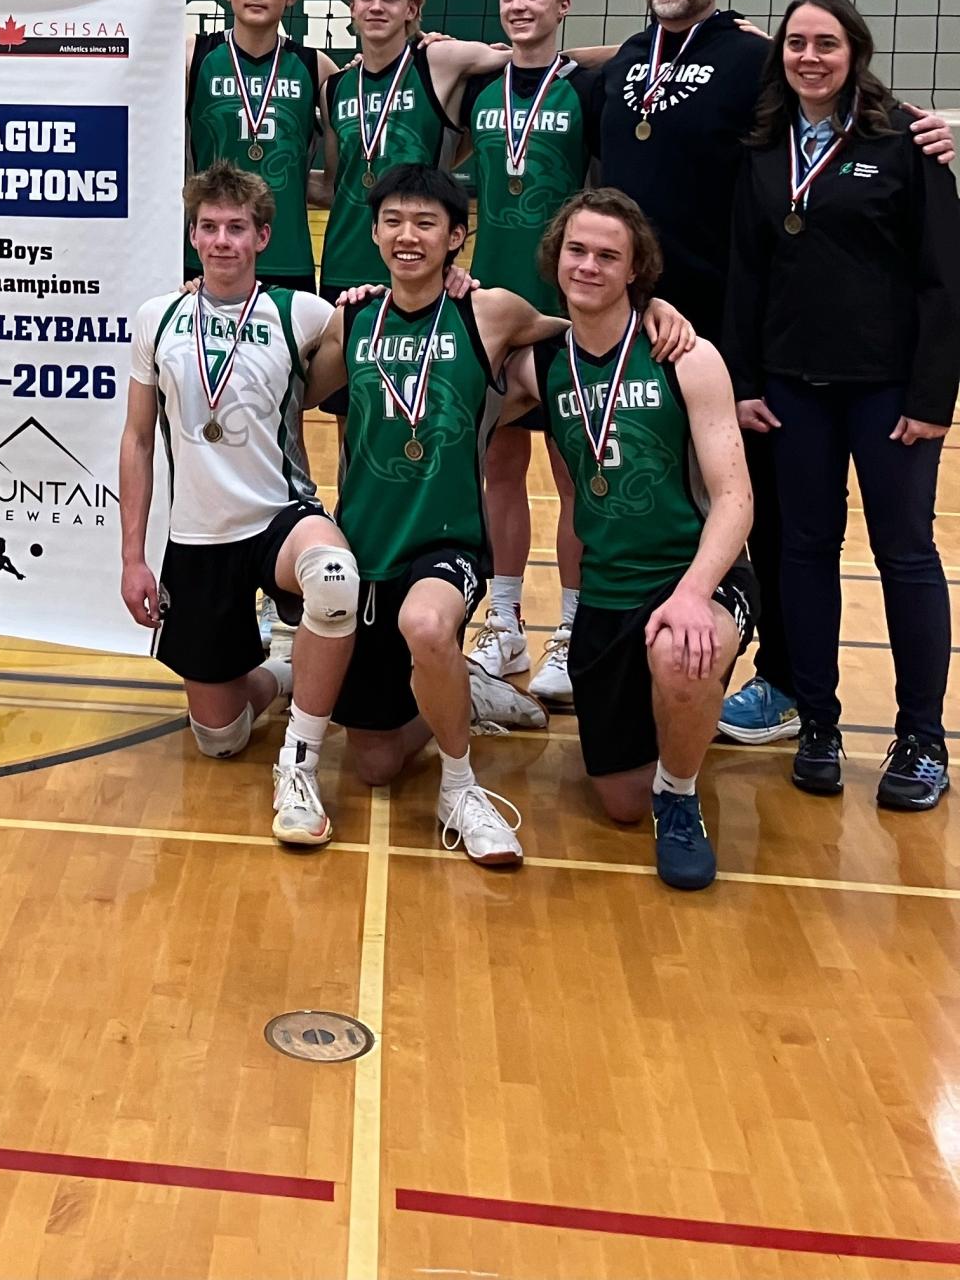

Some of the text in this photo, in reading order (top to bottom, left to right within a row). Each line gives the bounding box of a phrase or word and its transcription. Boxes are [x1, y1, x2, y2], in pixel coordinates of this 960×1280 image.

[33, 22, 126, 37] CSHSAA
[59, 45, 125, 53] Athletics since 1913
[211, 77, 302, 99] COGRS
[337, 89, 415, 120] COGRS
